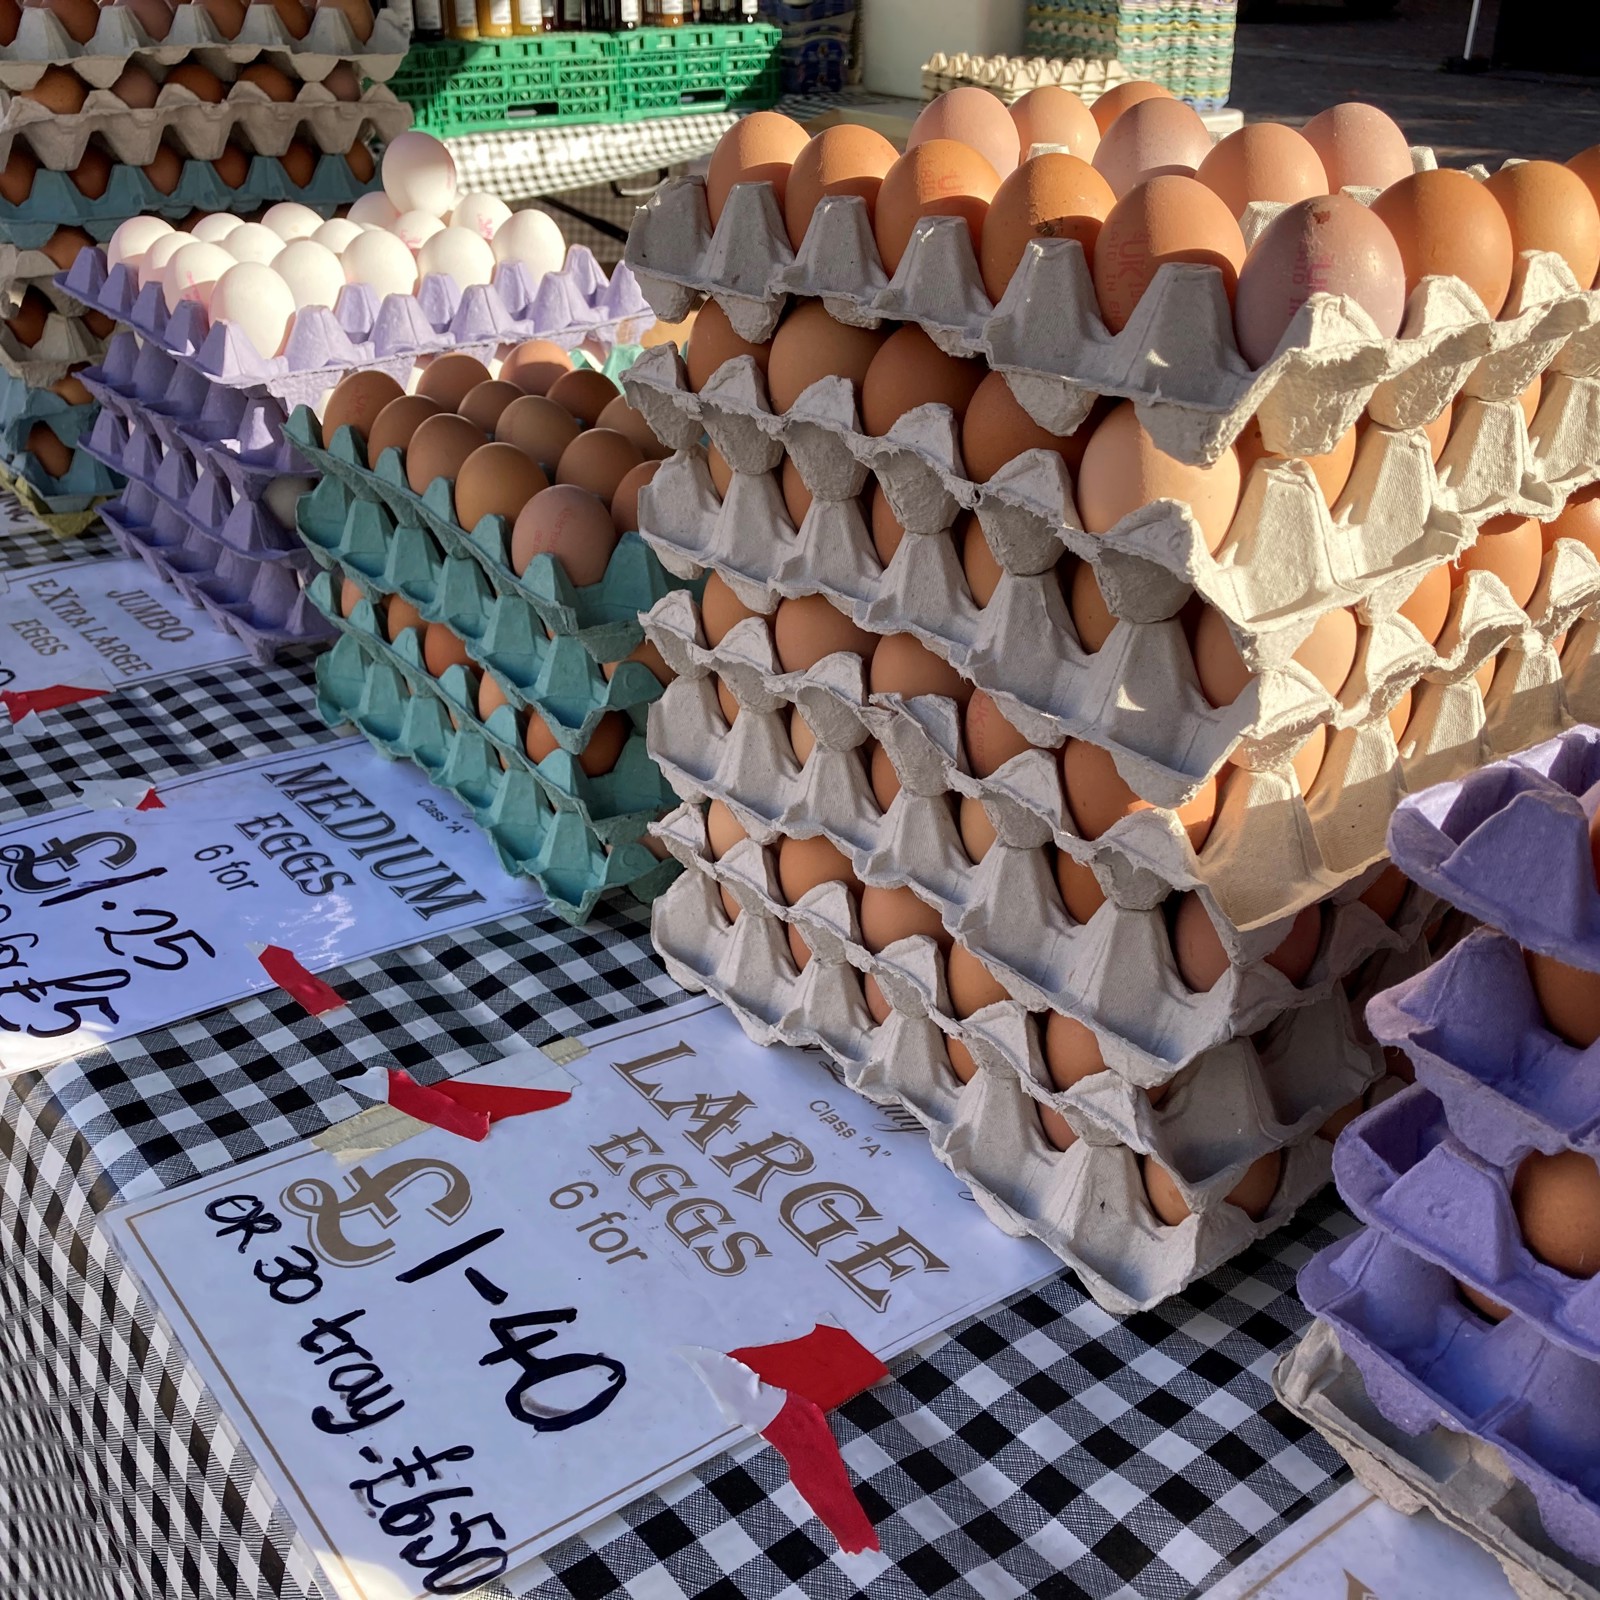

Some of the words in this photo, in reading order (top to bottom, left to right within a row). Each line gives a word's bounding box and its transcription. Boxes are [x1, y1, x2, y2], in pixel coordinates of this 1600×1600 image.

[9, 618, 71, 656] EGGS
[27, 577, 97, 629] EXTRA
[79, 626, 153, 676] LARGE
[105, 589, 195, 643] JUMBO
[261, 761, 488, 921] MEDIUM
[416, 798, 449, 822] Class
[194, 844, 234, 862] 6
[208, 860, 259, 892] for
[234, 812, 356, 897] EGGS
[809, 1099, 857, 1139] Class
[588, 1126, 773, 1278] EGGS
[609, 1040, 950, 1313] LARGE
[549, 1180, 599, 1211] 6
[575, 1210, 648, 1265] for
[252, 1244, 324, 1305] 30
[299, 1309, 405, 1435] tray
